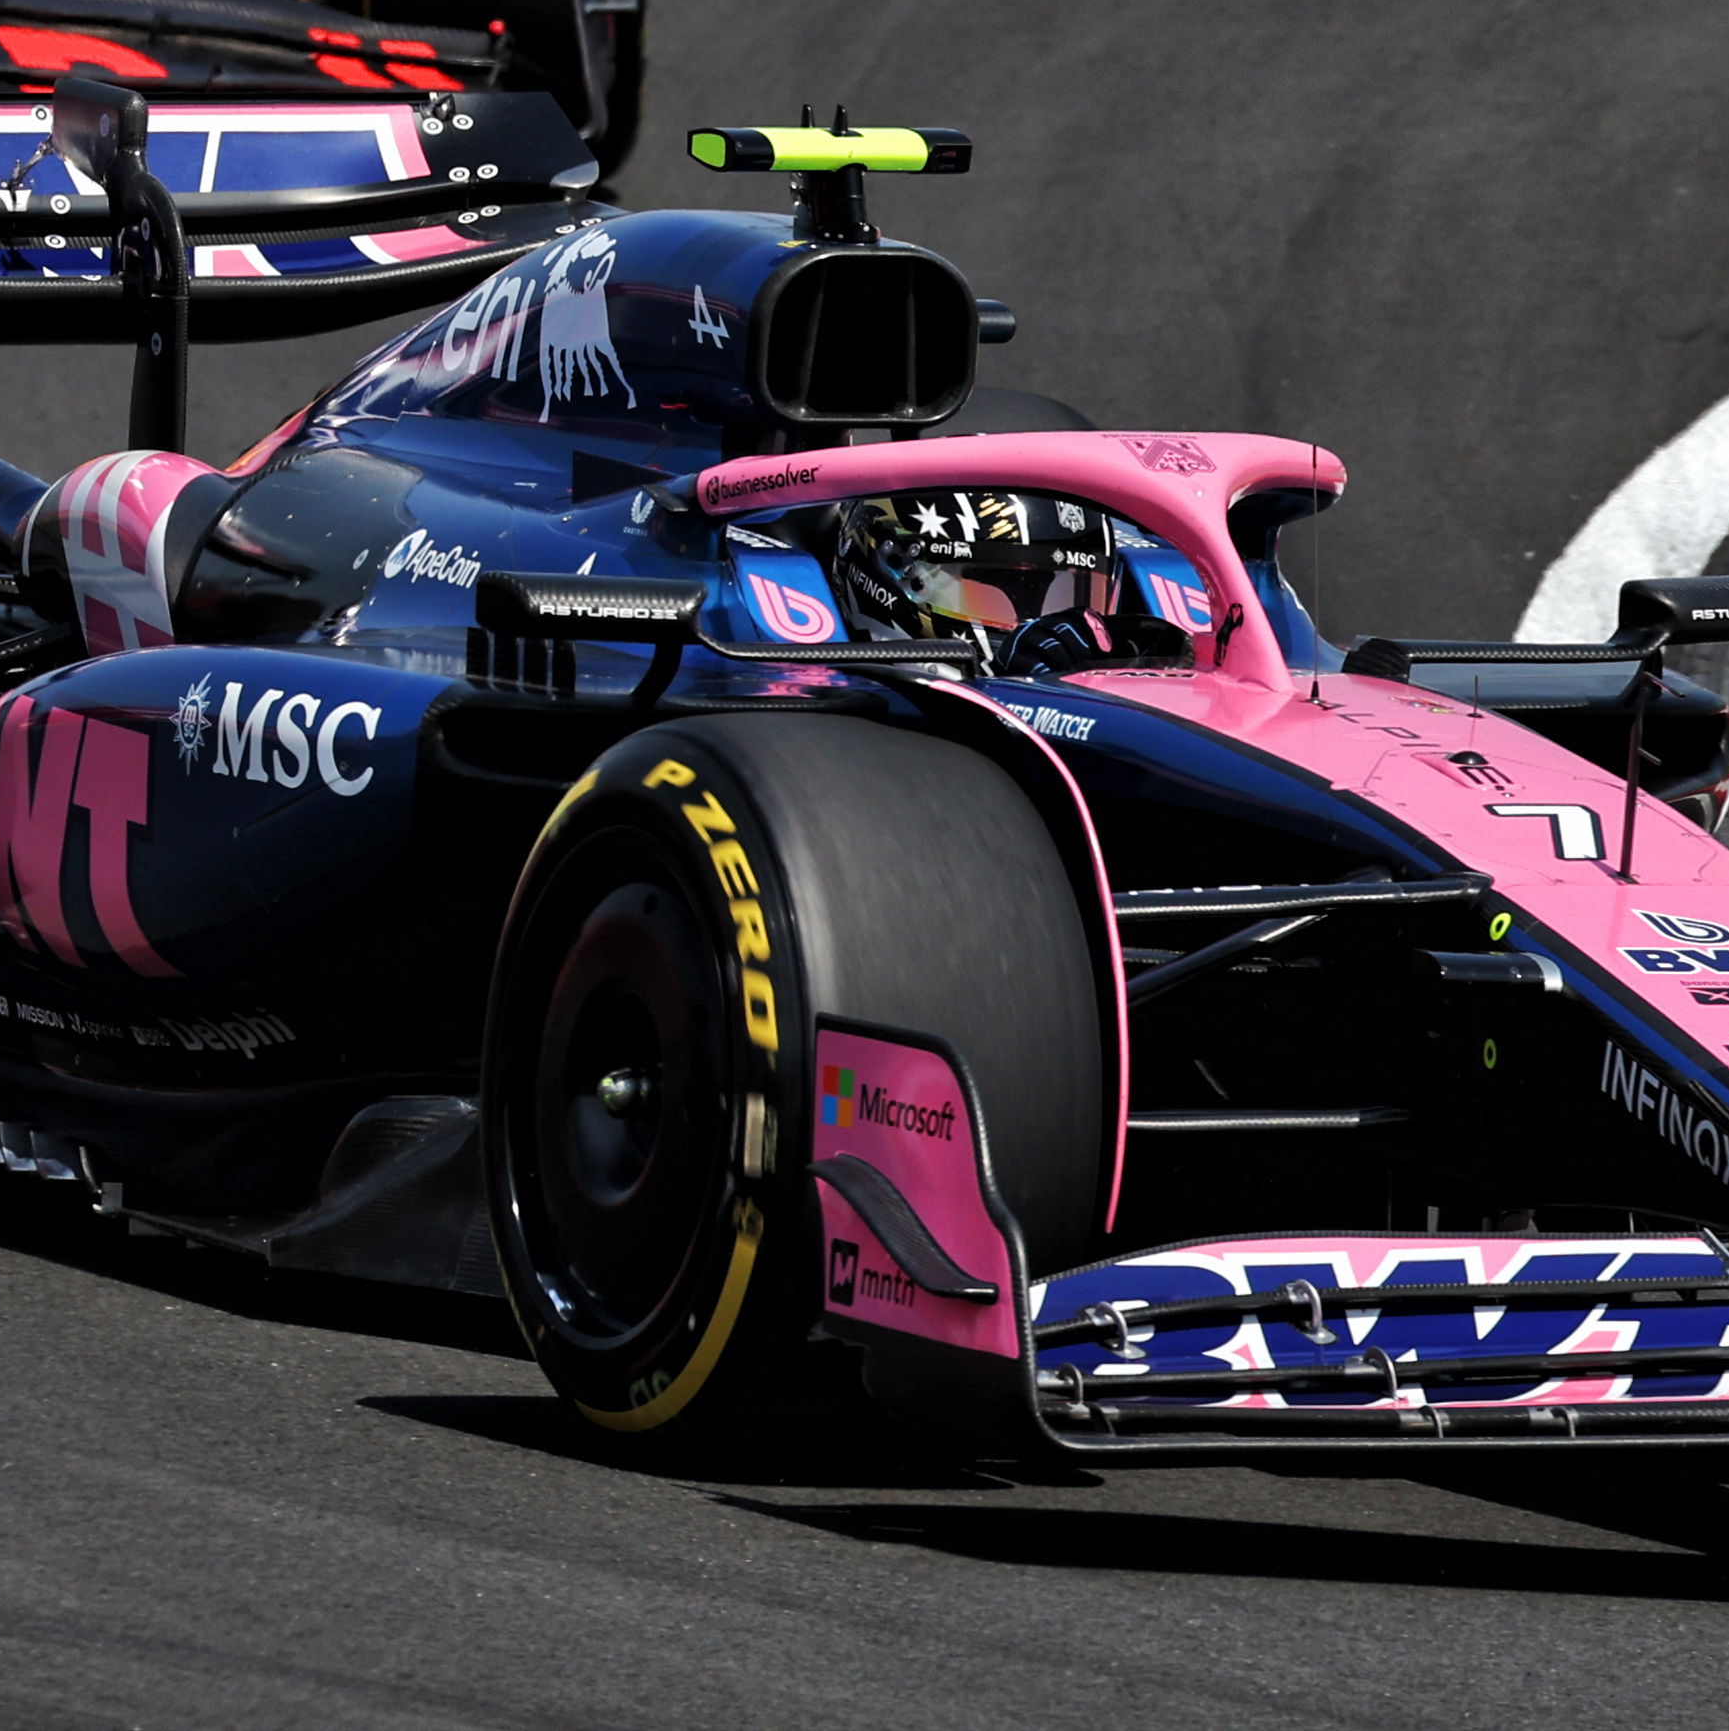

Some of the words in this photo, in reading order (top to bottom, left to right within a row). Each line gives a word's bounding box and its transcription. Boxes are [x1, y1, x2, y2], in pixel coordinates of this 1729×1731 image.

[441, 275, 536, 382] eni
[720, 464, 822, 502] businessolver
[408, 538, 480, 589] ApeCoin
[930, 541, 953, 556] eni
[1066, 550, 1097, 569] MSC
[848, 562, 898, 611] INFINOX
[212, 682, 382, 797] MSC
[1034, 706, 1097, 741] WATCH
[1483, 804, 1607, 861] 7
[643, 758, 696, 790] P
[681, 791, 780, 1053] ZERO
[16, 1001, 65, 1030] MISSION
[157, 1007, 297, 1060] Delphi
[859, 1082, 957, 1143] Microsoft
